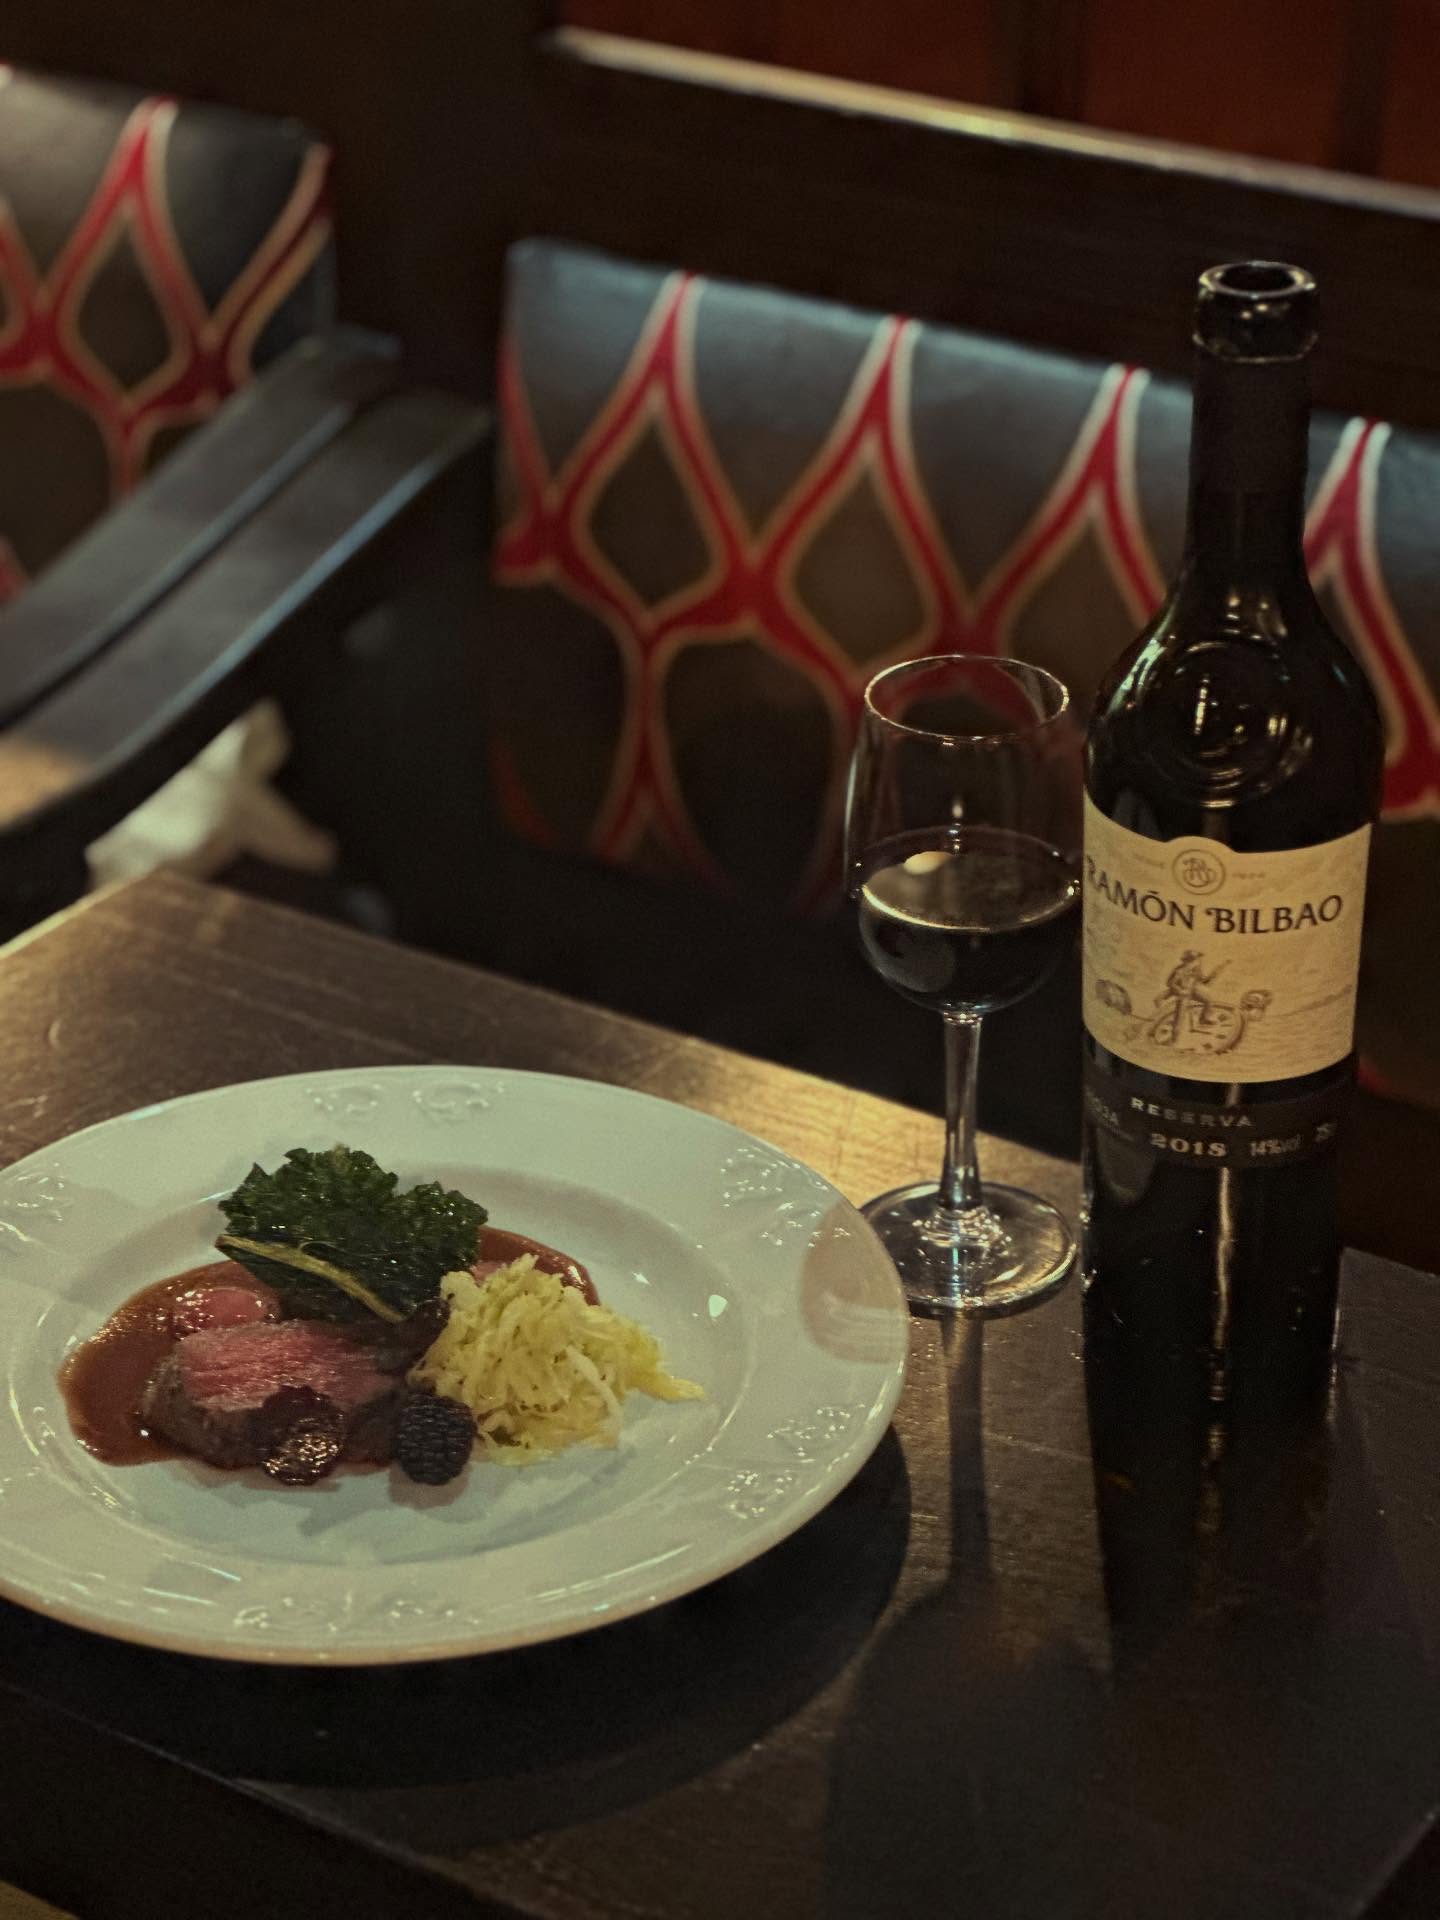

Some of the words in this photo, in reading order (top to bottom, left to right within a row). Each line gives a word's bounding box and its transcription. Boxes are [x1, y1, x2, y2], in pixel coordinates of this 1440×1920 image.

[1086, 855, 1195, 930] RAMÓN
[1205, 895, 1343, 934] BILBAO
[1130, 1096, 1254, 1127] RESERVA
